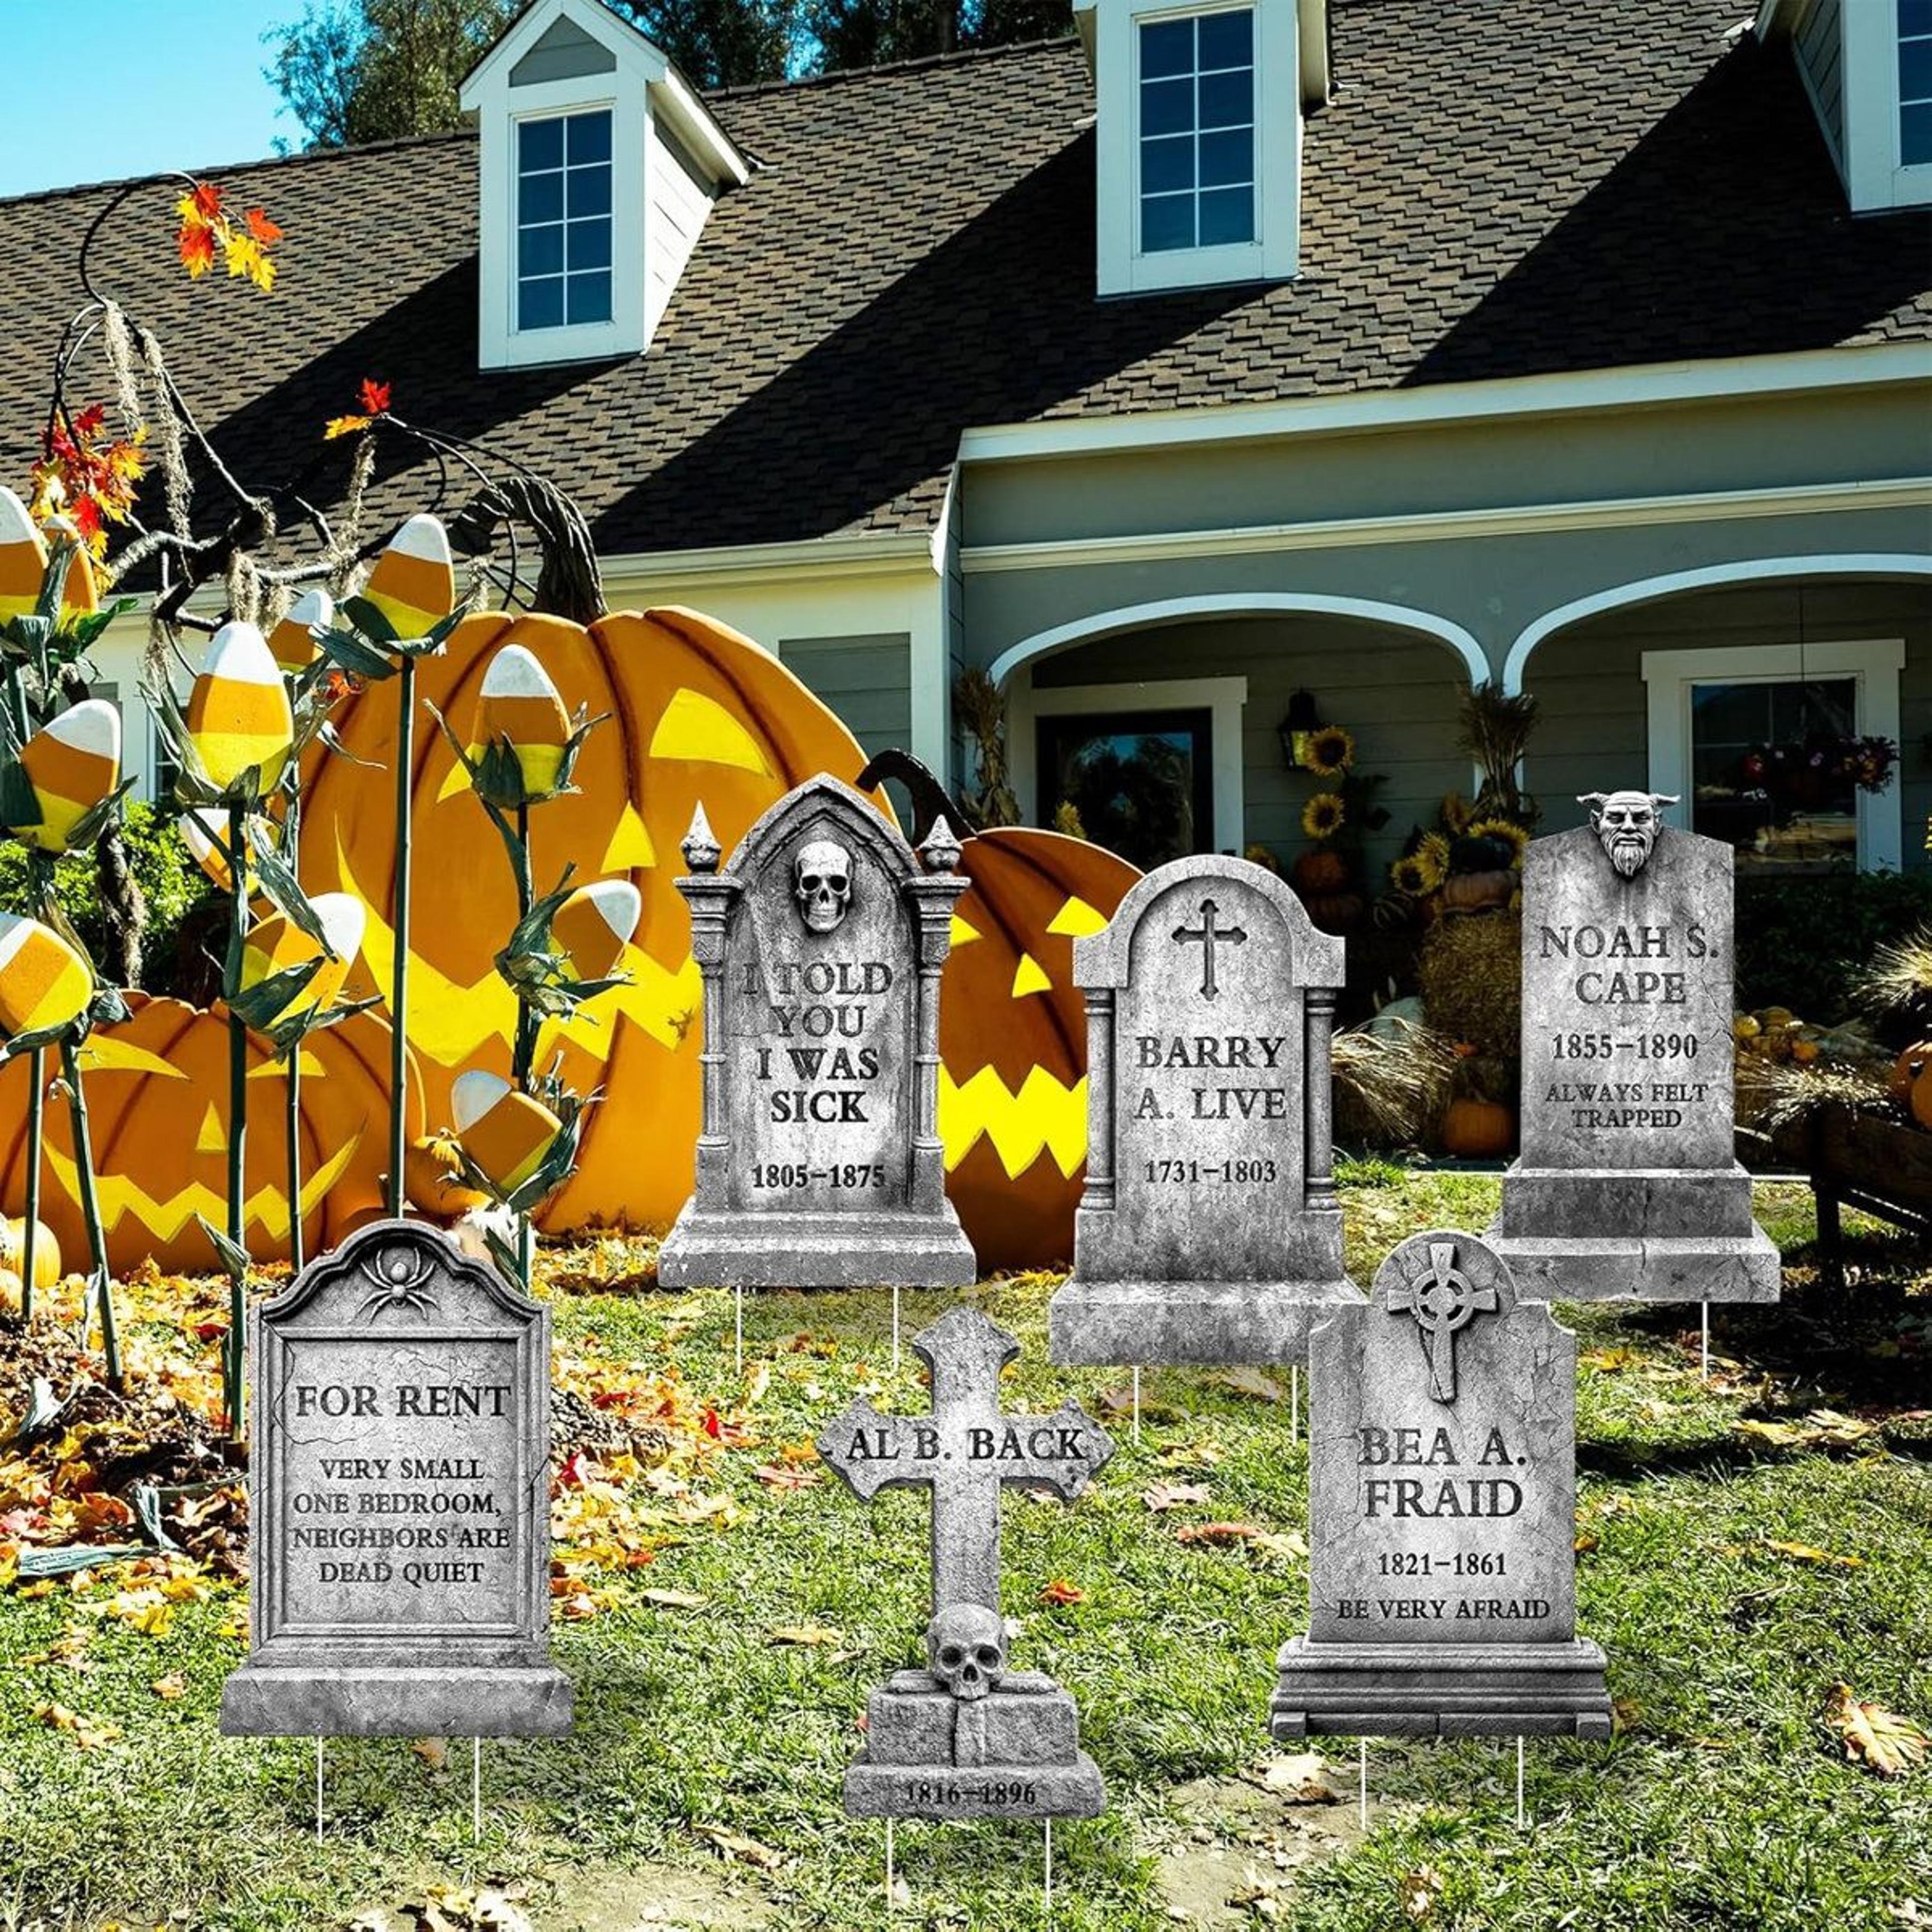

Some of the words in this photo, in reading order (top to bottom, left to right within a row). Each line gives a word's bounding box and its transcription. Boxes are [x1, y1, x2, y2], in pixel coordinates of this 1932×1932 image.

[1540, 925, 1669, 958] NOAH
[1686, 924, 1718, 958] S.
[743, 962, 758, 995] I
[772, 962, 893, 995] TOLD
[1575, 972, 1686, 1005] CAPE
[772, 1006, 865, 1038] YOU
[758, 1049, 772, 1080] I
[787, 1048, 879, 1080] WAS
[1135, 1036, 1285, 1068] BARRY
[771, 1091, 869, 1123] SICK
[1133, 1088, 1174, 1119] A.
[1191, 1088, 1286, 1119] LIVE
[1545, 1084, 1642, 1102] ALWAYS
[1651, 1084, 1708, 1102] FELT
[1572, 1109, 1681, 1127] TRAPPED
[296, 1386, 382, 1418] FOR
[395, 1385, 511, 1417] RENT
[846, 1428, 899, 1460] AL
[914, 1428, 952, 1460] B.
[969, 1428, 1086, 1460] BACK
[1358, 1427, 1460, 1466] BEA
[1478, 1427, 1527, 1466] A.
[319, 1460, 389, 1479] VERY
[400, 1460, 484, 1480] SMALL
[293, 1493, 349, 1514] ONE
[359, 1493, 501, 1517] BEDROOM,
[1363, 1479, 1523, 1517] FRAID
[292, 1527, 447, 1549] NEIGHBORS
[456, 1528, 510, 1548] ARE
[319, 1563, 393, 1583] DEAD
[403, 1563, 484, 1588] QUIET
[1338, 1600, 1370, 1618] BE
[1378, 1600, 1446, 1618] VERY
[1454, 1600, 1551, 1619] AFRAID
